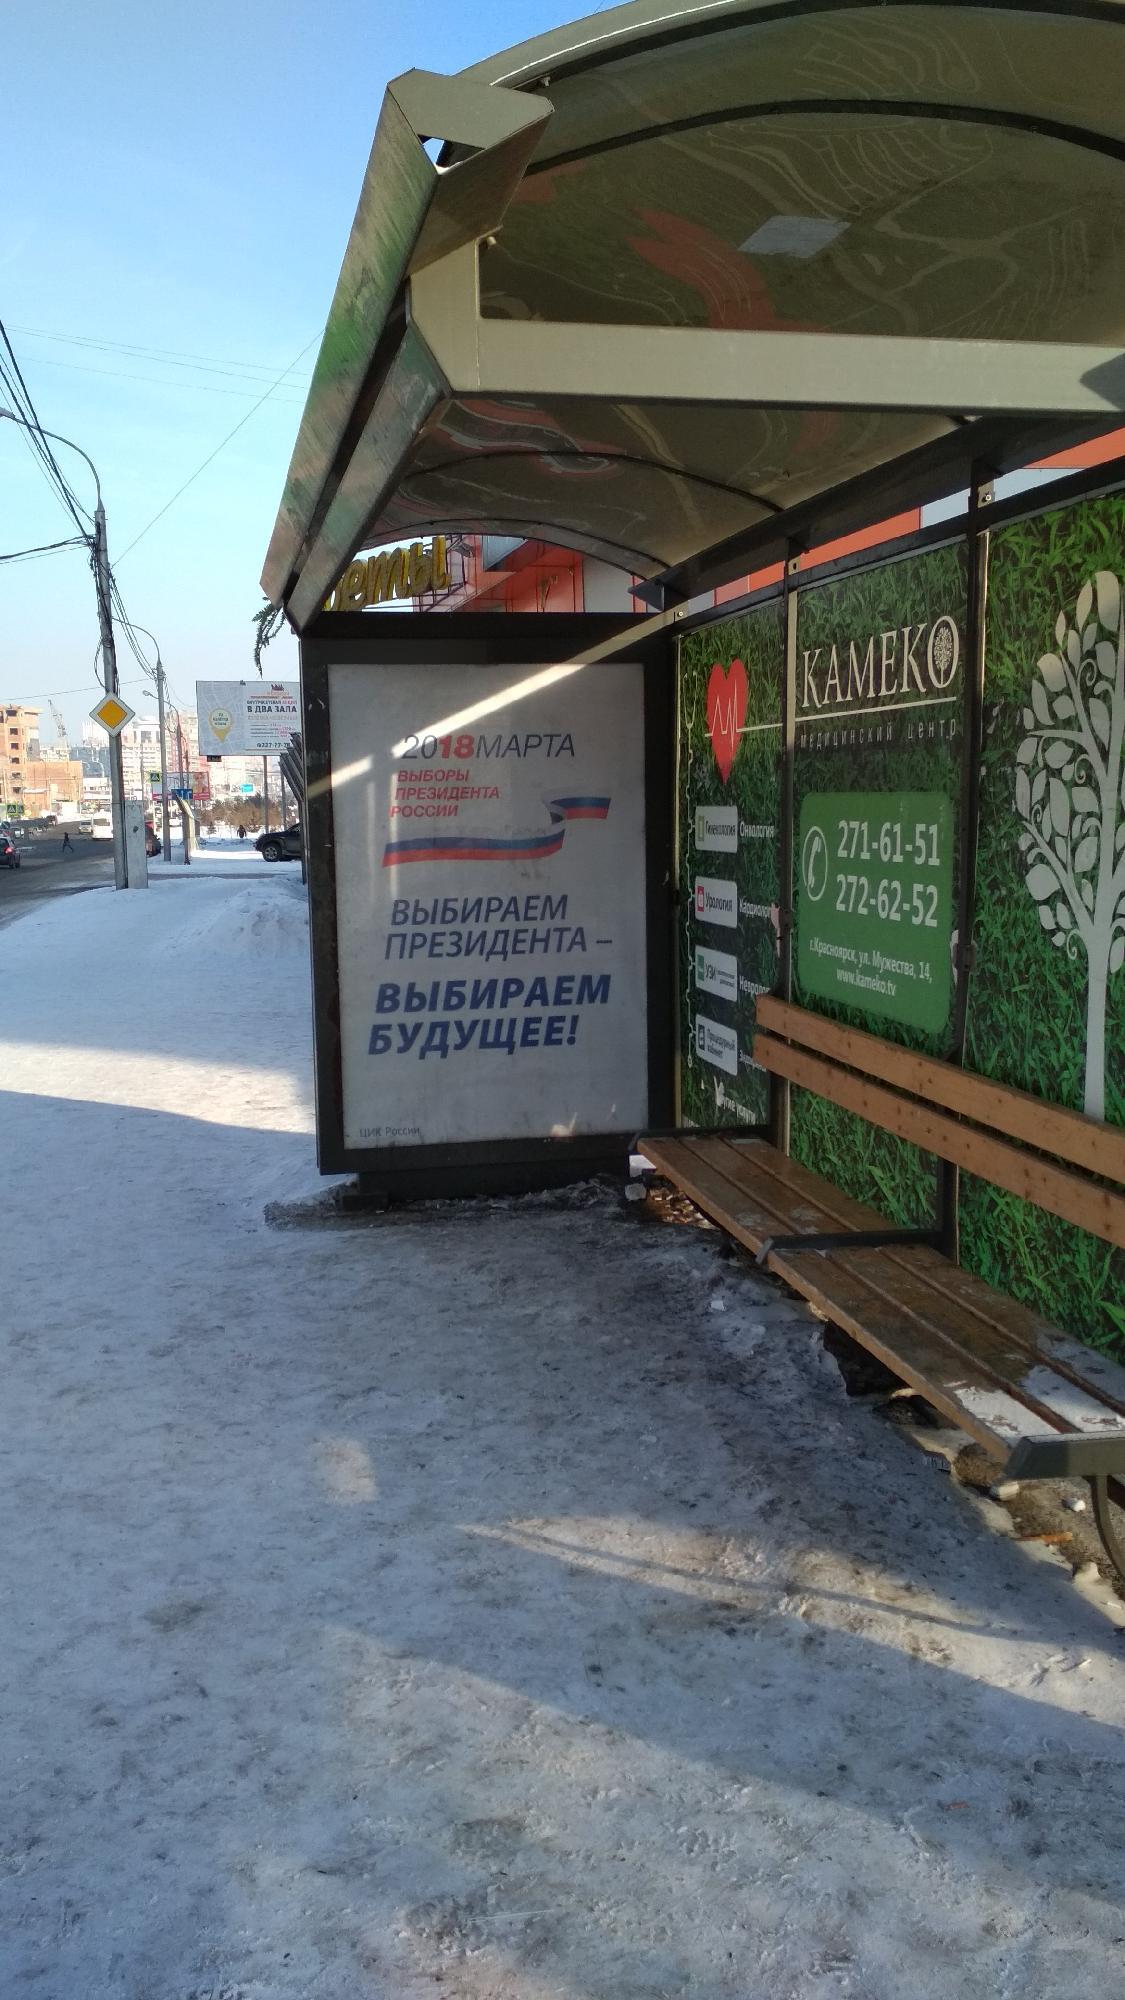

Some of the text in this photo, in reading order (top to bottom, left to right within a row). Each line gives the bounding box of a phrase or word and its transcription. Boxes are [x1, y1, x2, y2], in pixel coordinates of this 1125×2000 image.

[801, 719, 956, 750] медицинский центр
[397, 769, 469, 783] ВЫБОРЫ
[395, 786, 500, 801] ПРЕЗИДЕНТА
[390, 804, 459, 818] РОССИИ
[740, 820, 775, 838] Онкология
[837, 819, 940, 866] 271-61-51
[391, 894, 569, 926] ВЫБИРАЕМ
[705, 892, 733, 913] Урология
[836, 873, 938, 928] 272-62-52
[384, 926, 588, 962] ПРЕЗИДЕНТА
[836, 968, 897, 997] www.kameko.tv
[859, 951, 871, 968] ул.
[872, 950, 917, 979] Мужества,
[919, 961, 933, 984] 14,
[375, 974, 612, 1014] ВЫБИРАЕМ
[368, 1014, 580, 1060] БУДУЩЕЕ!
[359, 1126, 420, 1138] ЦИК России
